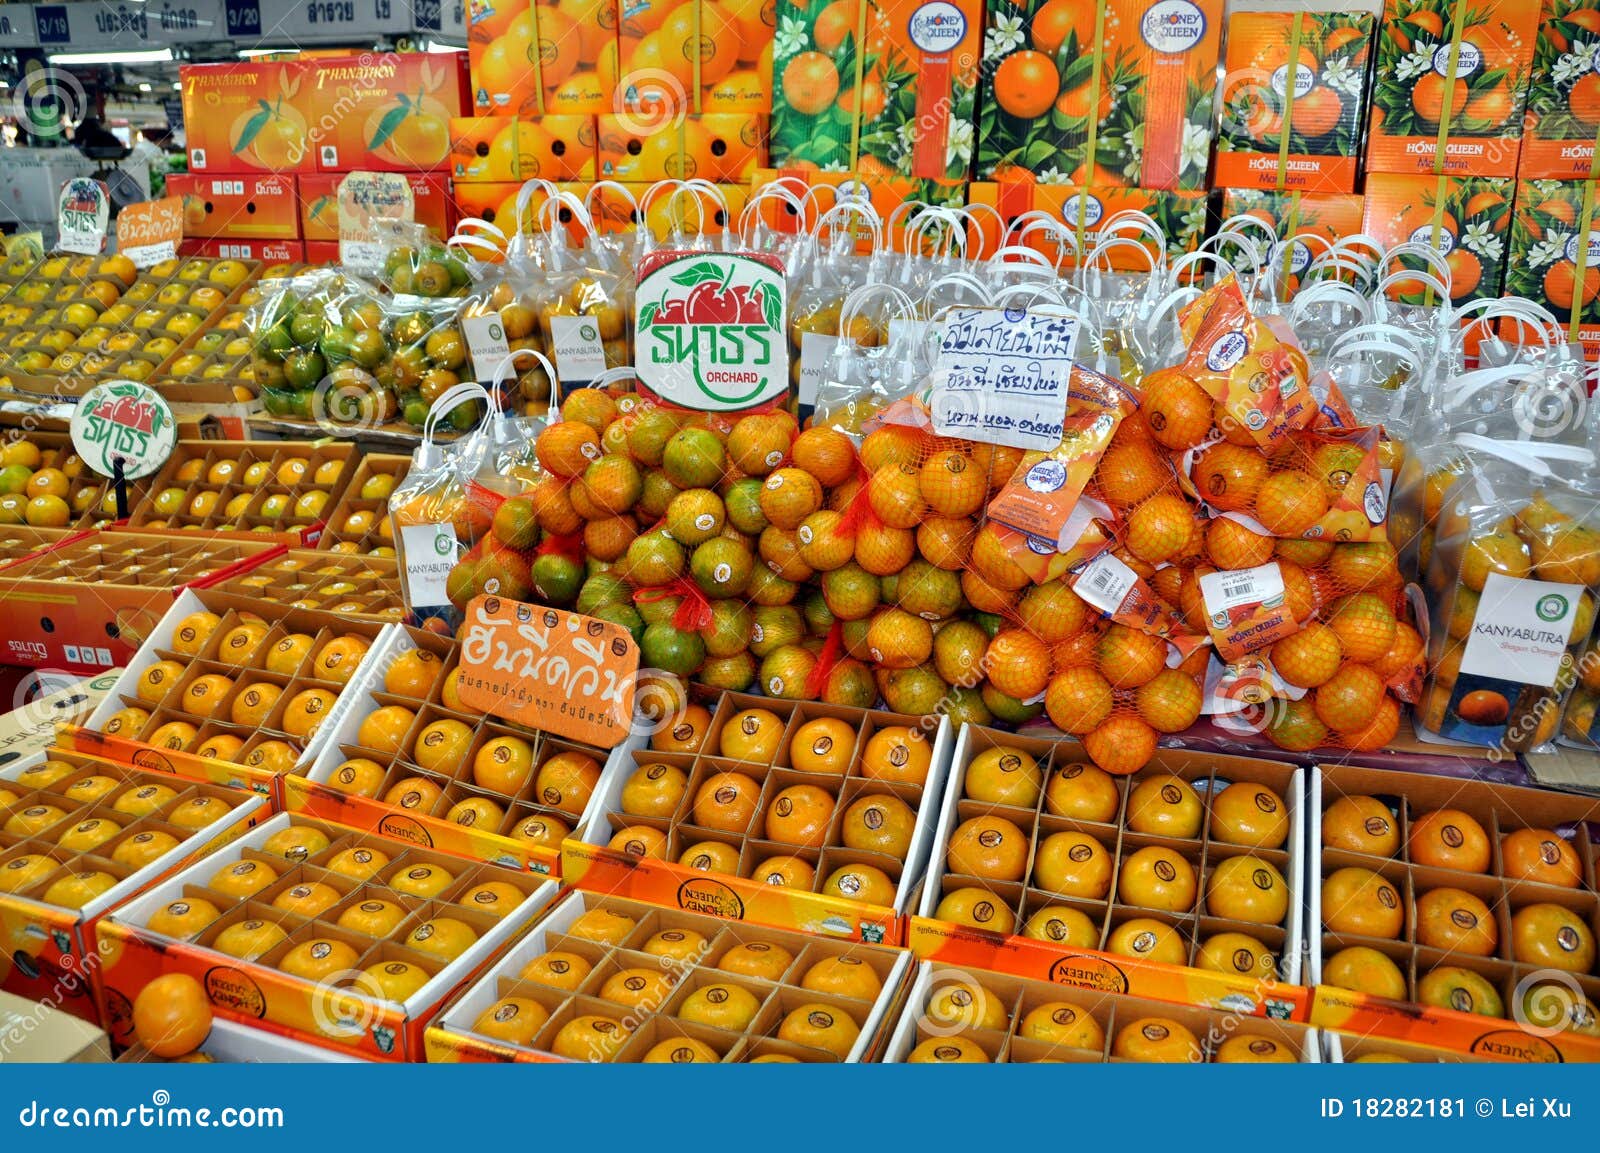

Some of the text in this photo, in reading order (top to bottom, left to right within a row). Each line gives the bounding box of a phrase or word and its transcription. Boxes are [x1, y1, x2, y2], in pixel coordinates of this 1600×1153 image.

[39, 15, 68, 34] 3/19
[228, 8, 259, 27] 3/20
[926, 27, 960, 38] QUEEN
[1161, 26, 1199, 38] QUEEN
[1446, 144, 1484, 155] QUEEN
[1286, 160, 1320, 172] QUEEN
[706, 371, 758, 384] ORCHARD
[1475, 623, 1564, 646] KANYABUTRA
[685, 889, 721, 906] QUEEN
[1058, 966, 1102, 983] QUEEN
[1482, 1040, 1537, 1060] QUEEN
